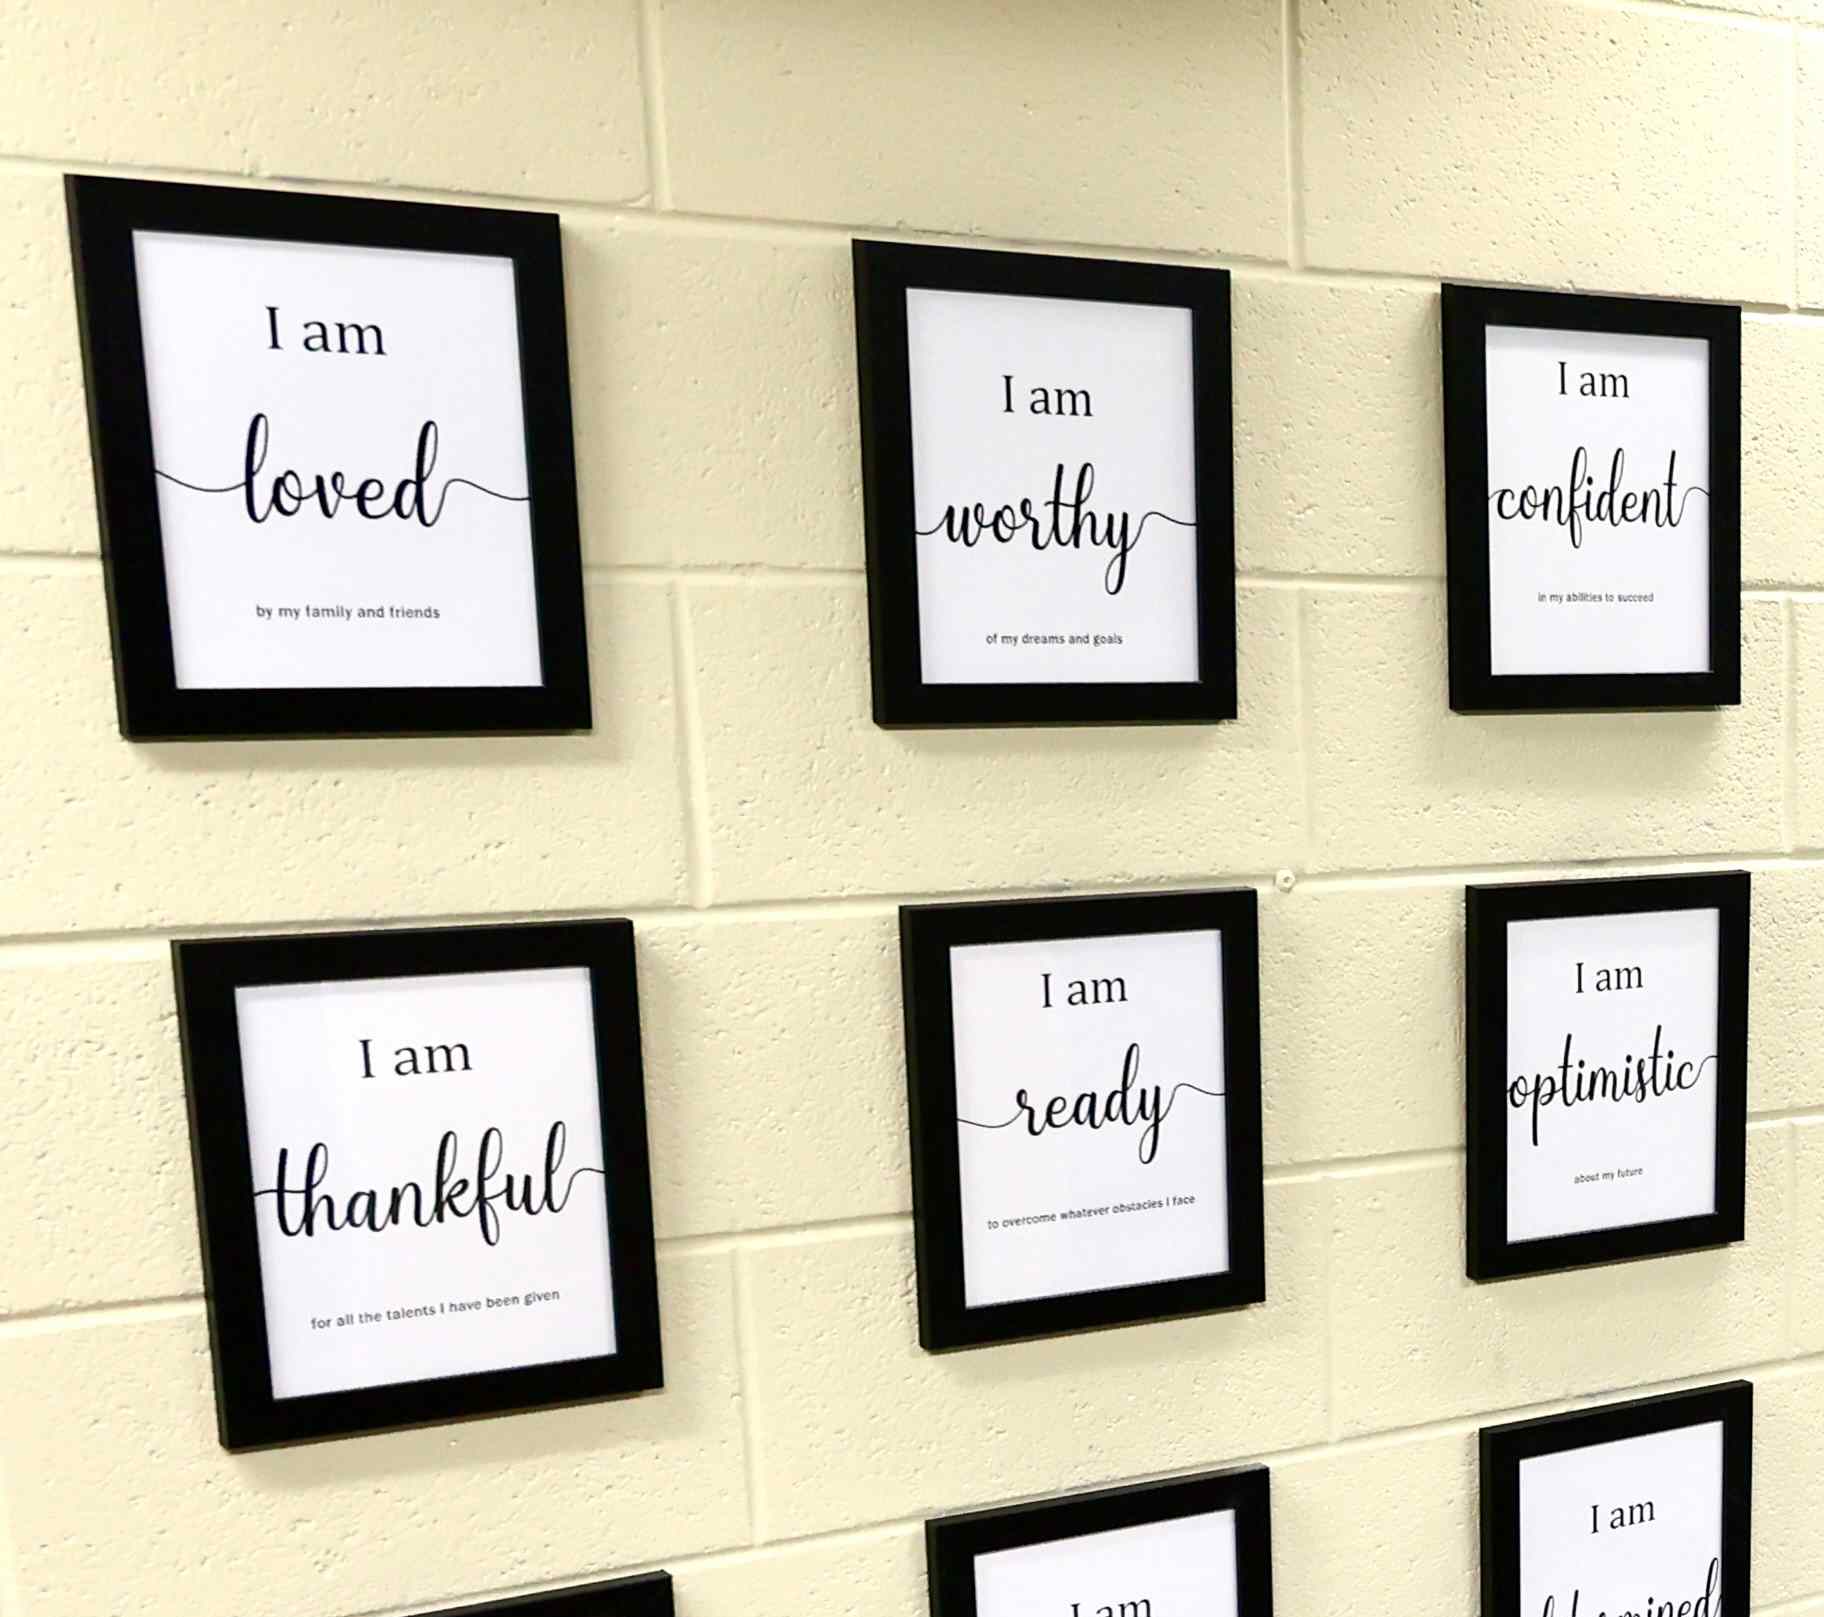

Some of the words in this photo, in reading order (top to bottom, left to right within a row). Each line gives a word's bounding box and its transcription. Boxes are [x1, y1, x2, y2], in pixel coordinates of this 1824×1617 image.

[266, 306, 280, 349] I
[302, 319, 387, 355] am
[1002, 375, 1014, 413] I
[1030, 384, 1093, 417] am
[1559, 362, 1567, 395] I
[1579, 372, 1629, 398] am
[224, 413, 463, 527] loved
[1492, 446, 1695, 549] confident
[930, 463, 1153, 595] worthy
[256, 603, 273, 620] by
[278, 604, 300, 620] my
[306, 603, 353, 621] family
[358, 603, 384, 619] and
[389, 603, 441, 619] friends
[1538, 592, 1547, 602] in
[1550, 594, 1563, 603] my
[1566, 592, 1602, 602] abilities
[1606, 592, 1614, 602] to
[1617, 592, 1654, 602] succeed
[986, 633, 998, 645] of
[1001, 634, 1018, 646] my
[1022, 632, 1065, 645] dreams
[1069, 633, 1089, 645] and
[1094, 633, 1123, 647] goals
[1042, 974, 1052, 1008] I
[1067, 975, 1128, 1006] am
[1576, 963, 1584, 993] I
[1595, 965, 1643, 992] am
[360, 1039, 373, 1078] I
[394, 1041, 472, 1076] am
[1012, 1043, 1181, 1164] ready
[1508, 1025, 1707, 1146] optimistic
[269, 1121, 576, 1246] thankful
[1574, 1172, 1600, 1184] about
[1602, 1171, 1615, 1182] my
[1617, 1166, 1643, 1178] future
[988, 1219, 999, 1229] to
[1002, 1212, 1056, 1229] overcome
[1060, 1205, 1110, 1221] whatever
[1113, 1198, 1163, 1214] obstacles
[1172, 1194, 1196, 1206] face
[311, 1316, 332, 1330] for
[337, 1313, 354, 1328] all
[359, 1311, 382, 1325] the
[386, 1303, 436, 1322] talents
[448, 1298, 482, 1313] have
[486, 1293, 520, 1309] been
[525, 1288, 560, 1307] given
[1591, 1505, 1600, 1534] I
[1610, 1501, 1655, 1530] am
